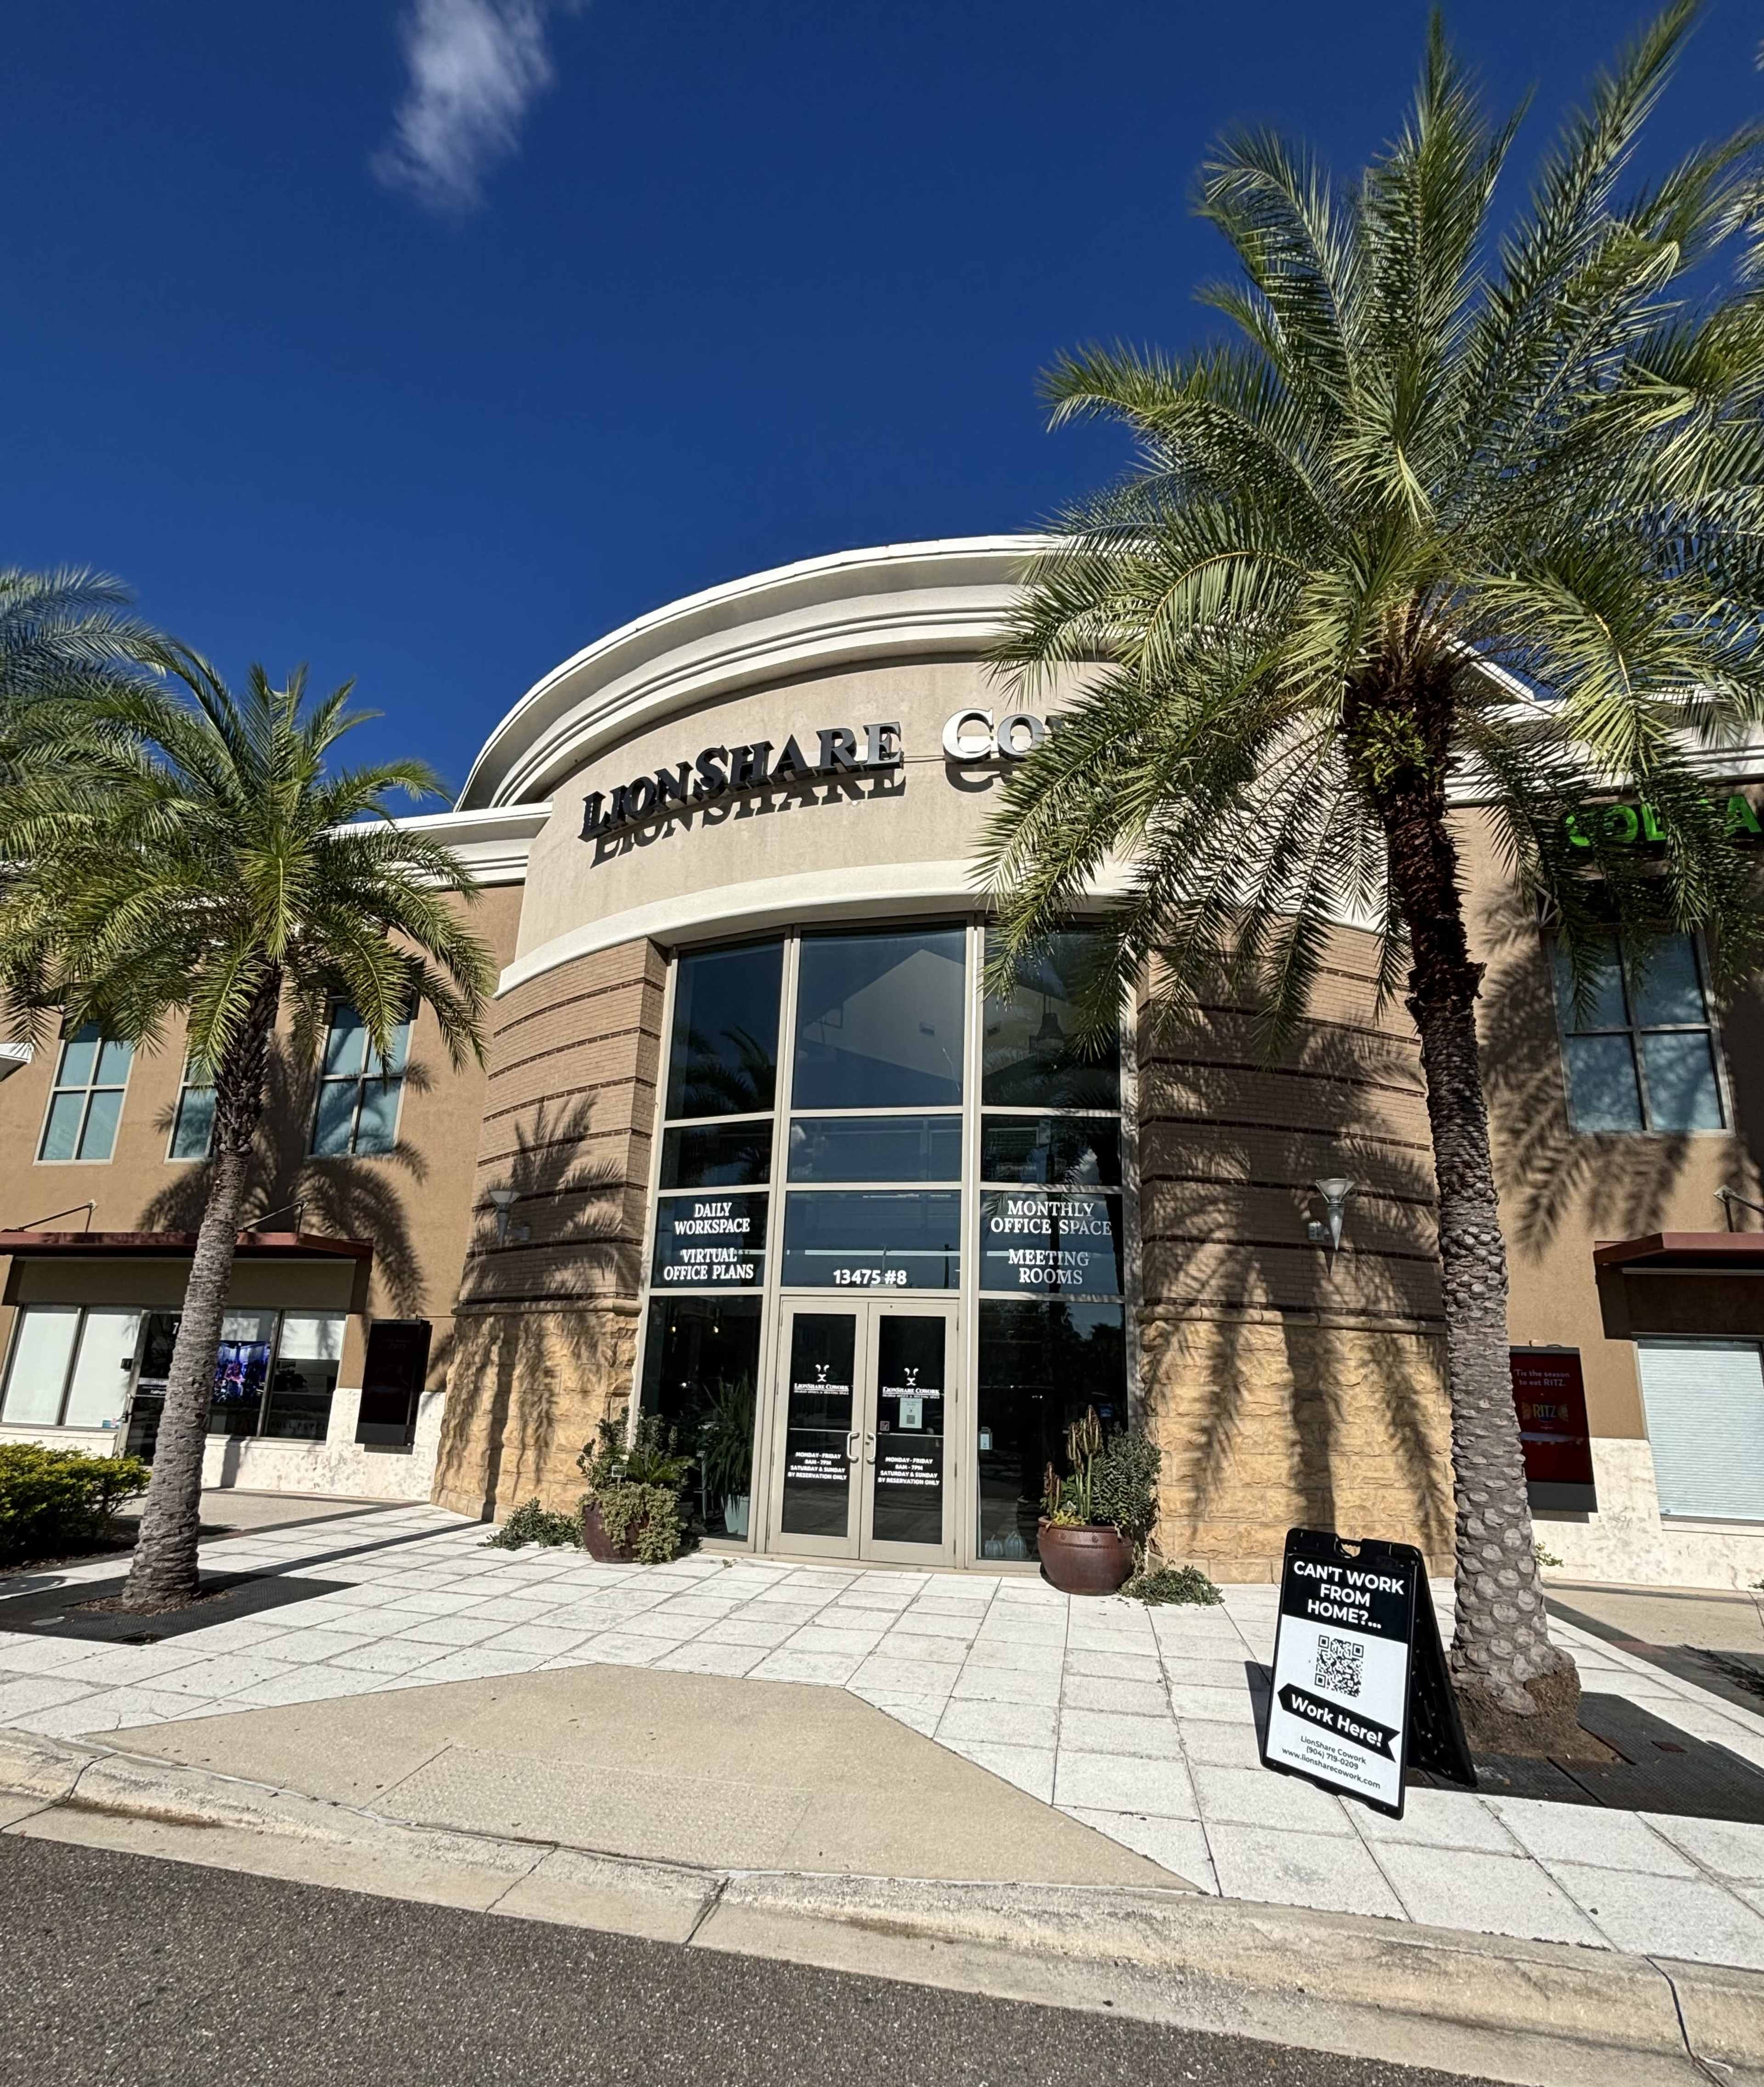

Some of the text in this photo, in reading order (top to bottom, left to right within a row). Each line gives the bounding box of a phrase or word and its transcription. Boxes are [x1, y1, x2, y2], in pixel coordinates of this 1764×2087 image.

[694, 1202, 732, 1217] DAILY
[1007, 1199, 1095, 1218] MONTHLY
[674, 1218, 750, 1235] WORKSPACE
[990, 1218, 1112, 1236] OFFICE SPACE
[682, 1248, 737, 1264] VIRTUAL
[1008, 1249, 1089, 1267] MEETING
[664, 1264, 754, 1281] OFFICE PLANS
[833, 1269, 907, 1284] 13475 #8
[1019, 1267, 1083, 1284] ROOMS
[1529, 1369, 1542, 1377] the
[1532, 1403, 1557, 1419] RITZ
[1294, 1561, 1404, 1595] CAN'T WORK
[1320, 1584, 1370, 1607] FROM
[1307, 1599, 1382, 1629] HOME?...
[1291, 1693, 1383, 1748] Work Here!
[1300, 1736, 1367, 1765] LionShare Cowork
[1306, 1746, 1358, 1770] (904) 719-0209
[1282, 1748, 1381, 1789] www.lionsharecowork.com
